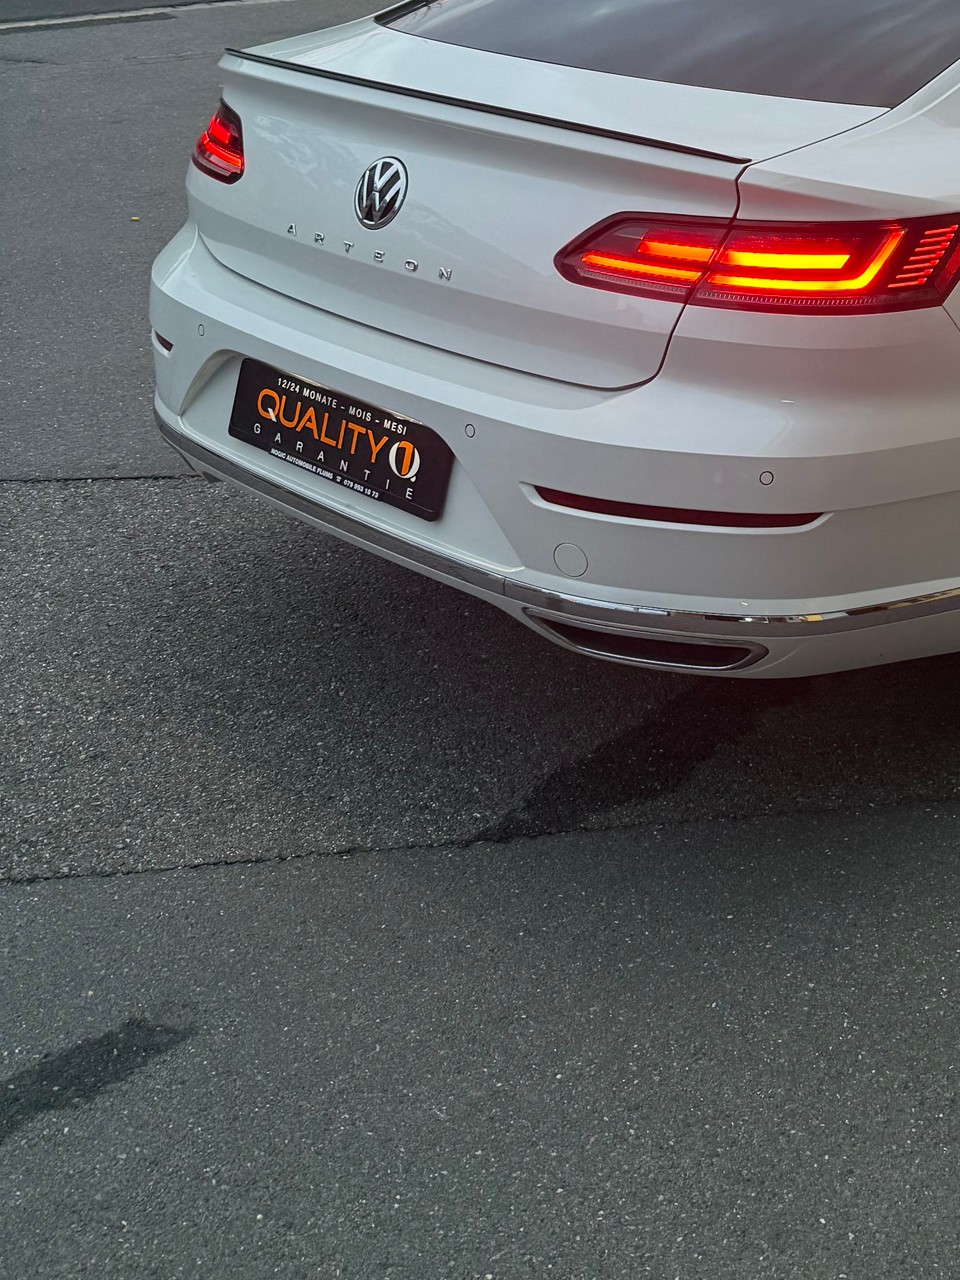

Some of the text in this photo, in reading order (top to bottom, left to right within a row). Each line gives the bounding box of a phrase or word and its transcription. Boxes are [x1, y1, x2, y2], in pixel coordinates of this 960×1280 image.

[287, 223, 453, 281] ARTEON
[277, 377, 300, 393] 12/24
[303, 387, 338, 409] MONATE
[349, 406, 372, 422] MOIS
[383, 420, 407, 436] MESI
[253, 423, 414, 500] GARANTIE
[286, 455, 317, 473] AUTOMOBILE
